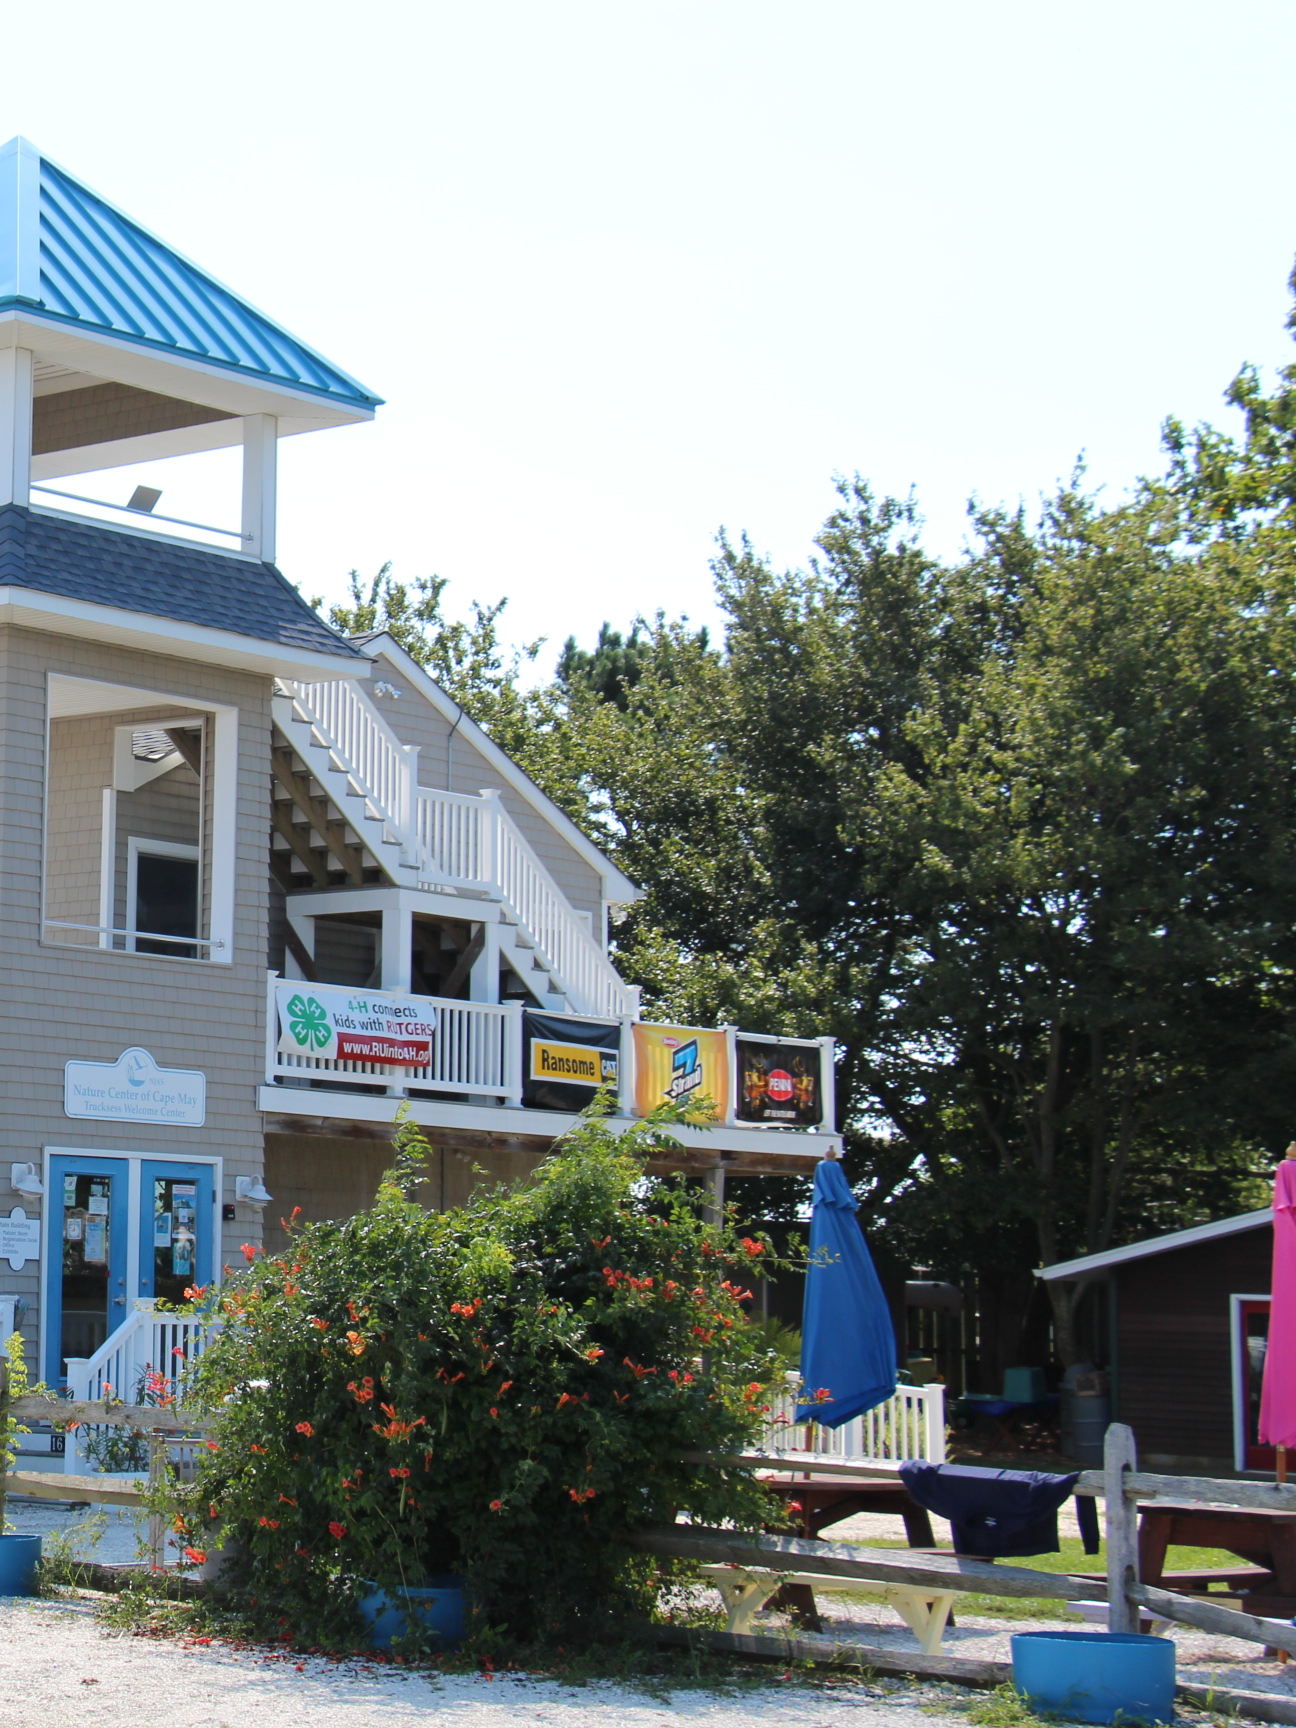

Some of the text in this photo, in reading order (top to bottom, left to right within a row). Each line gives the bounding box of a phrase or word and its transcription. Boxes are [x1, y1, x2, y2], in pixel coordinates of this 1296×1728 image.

[291, 1000, 305, 1015] H
[310, 1002, 321, 1017] H
[348, 1000, 417, 1018] 4-H connects
[295, 1023, 308, 1039] H
[332, 1013, 433, 1036] kids with RUTGERS
[316, 1026, 328, 1041] H
[541, 1048, 617, 1077] Ransome CAT
[769, 1077, 792, 1092] PENN
[73, 1084, 198, 1108] Nature Center of Cape May
[84, 1100, 186, 1118] Trucksess Welcome Center
[52, 1436, 63, 1451] 16
